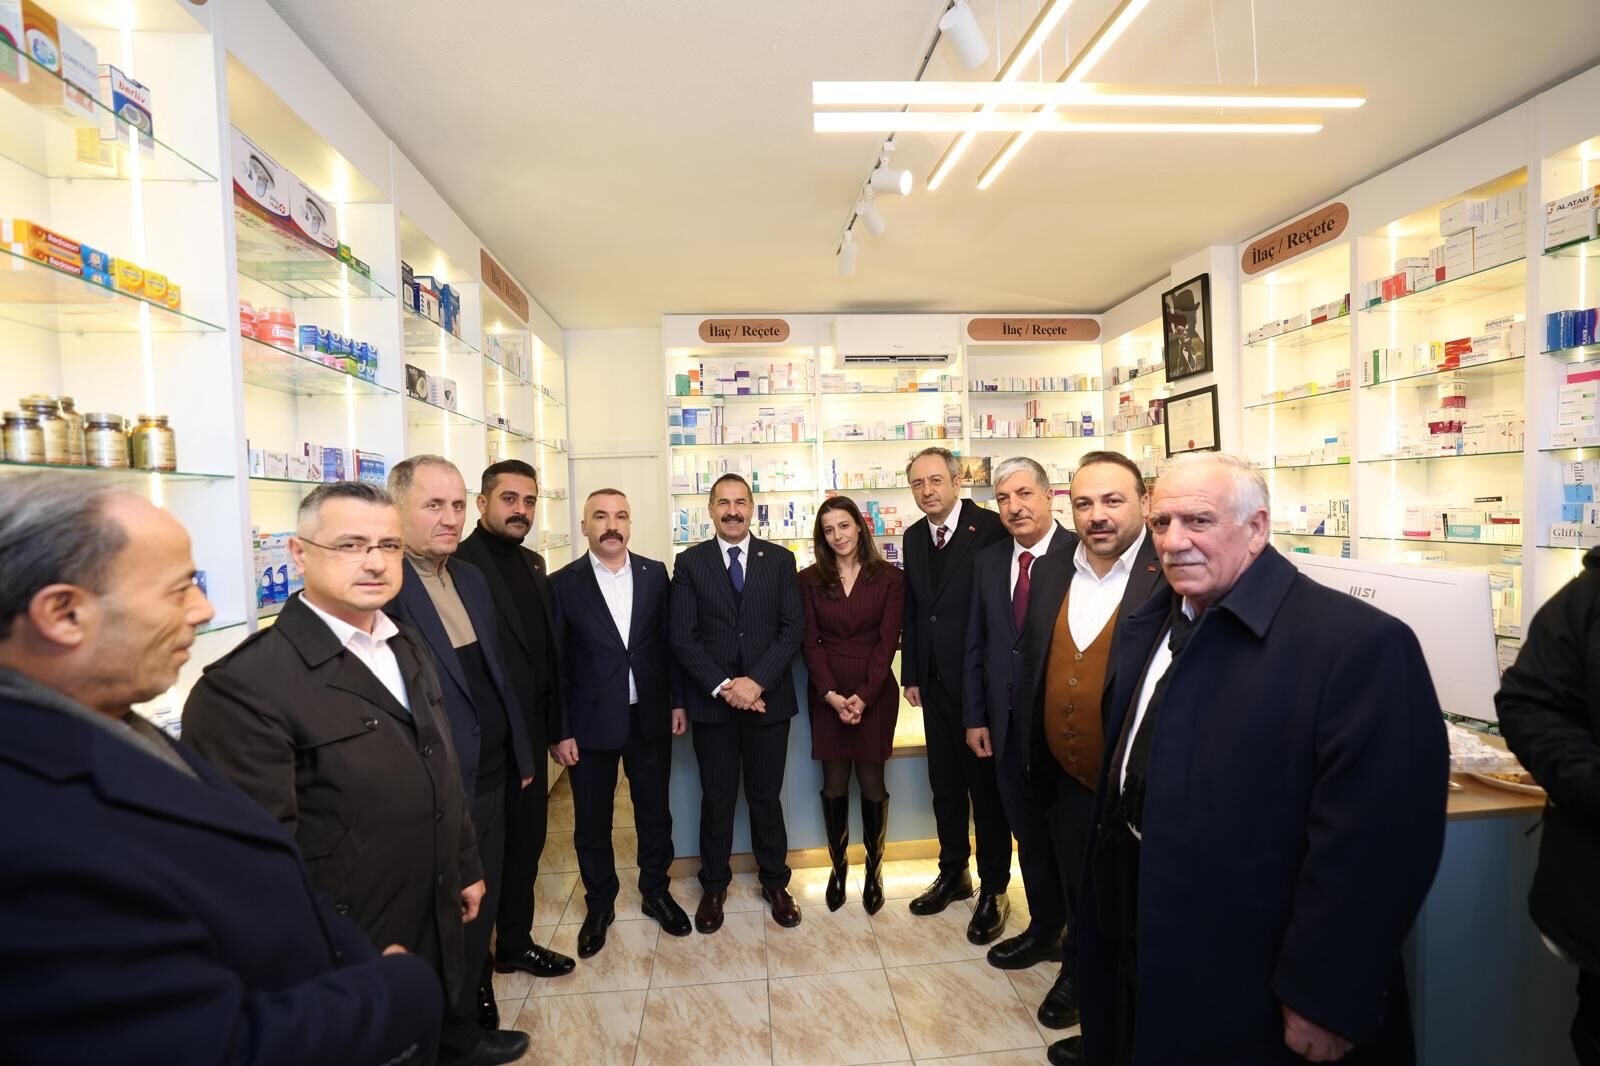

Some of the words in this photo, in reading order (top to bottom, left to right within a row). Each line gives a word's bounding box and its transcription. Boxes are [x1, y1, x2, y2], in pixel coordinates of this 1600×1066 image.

[118, 80, 146, 104] berliv
[1556, 195, 1590, 211] ALATAB
[1252, 246, 1275, 265] İlaç
[1278, 237, 1284, 254] /
[1287, 218, 1336, 250] Reçete
[709, 323, 732, 339] İlaç
[734, 325, 739, 337] /
[742, 325, 781, 339] Reçete
[1002, 322, 1023, 337] İlaç
[1025, 323, 1030, 335] /
[1032, 324, 1068, 337] Reçete
[1552, 527, 1584, 538] Glifix
